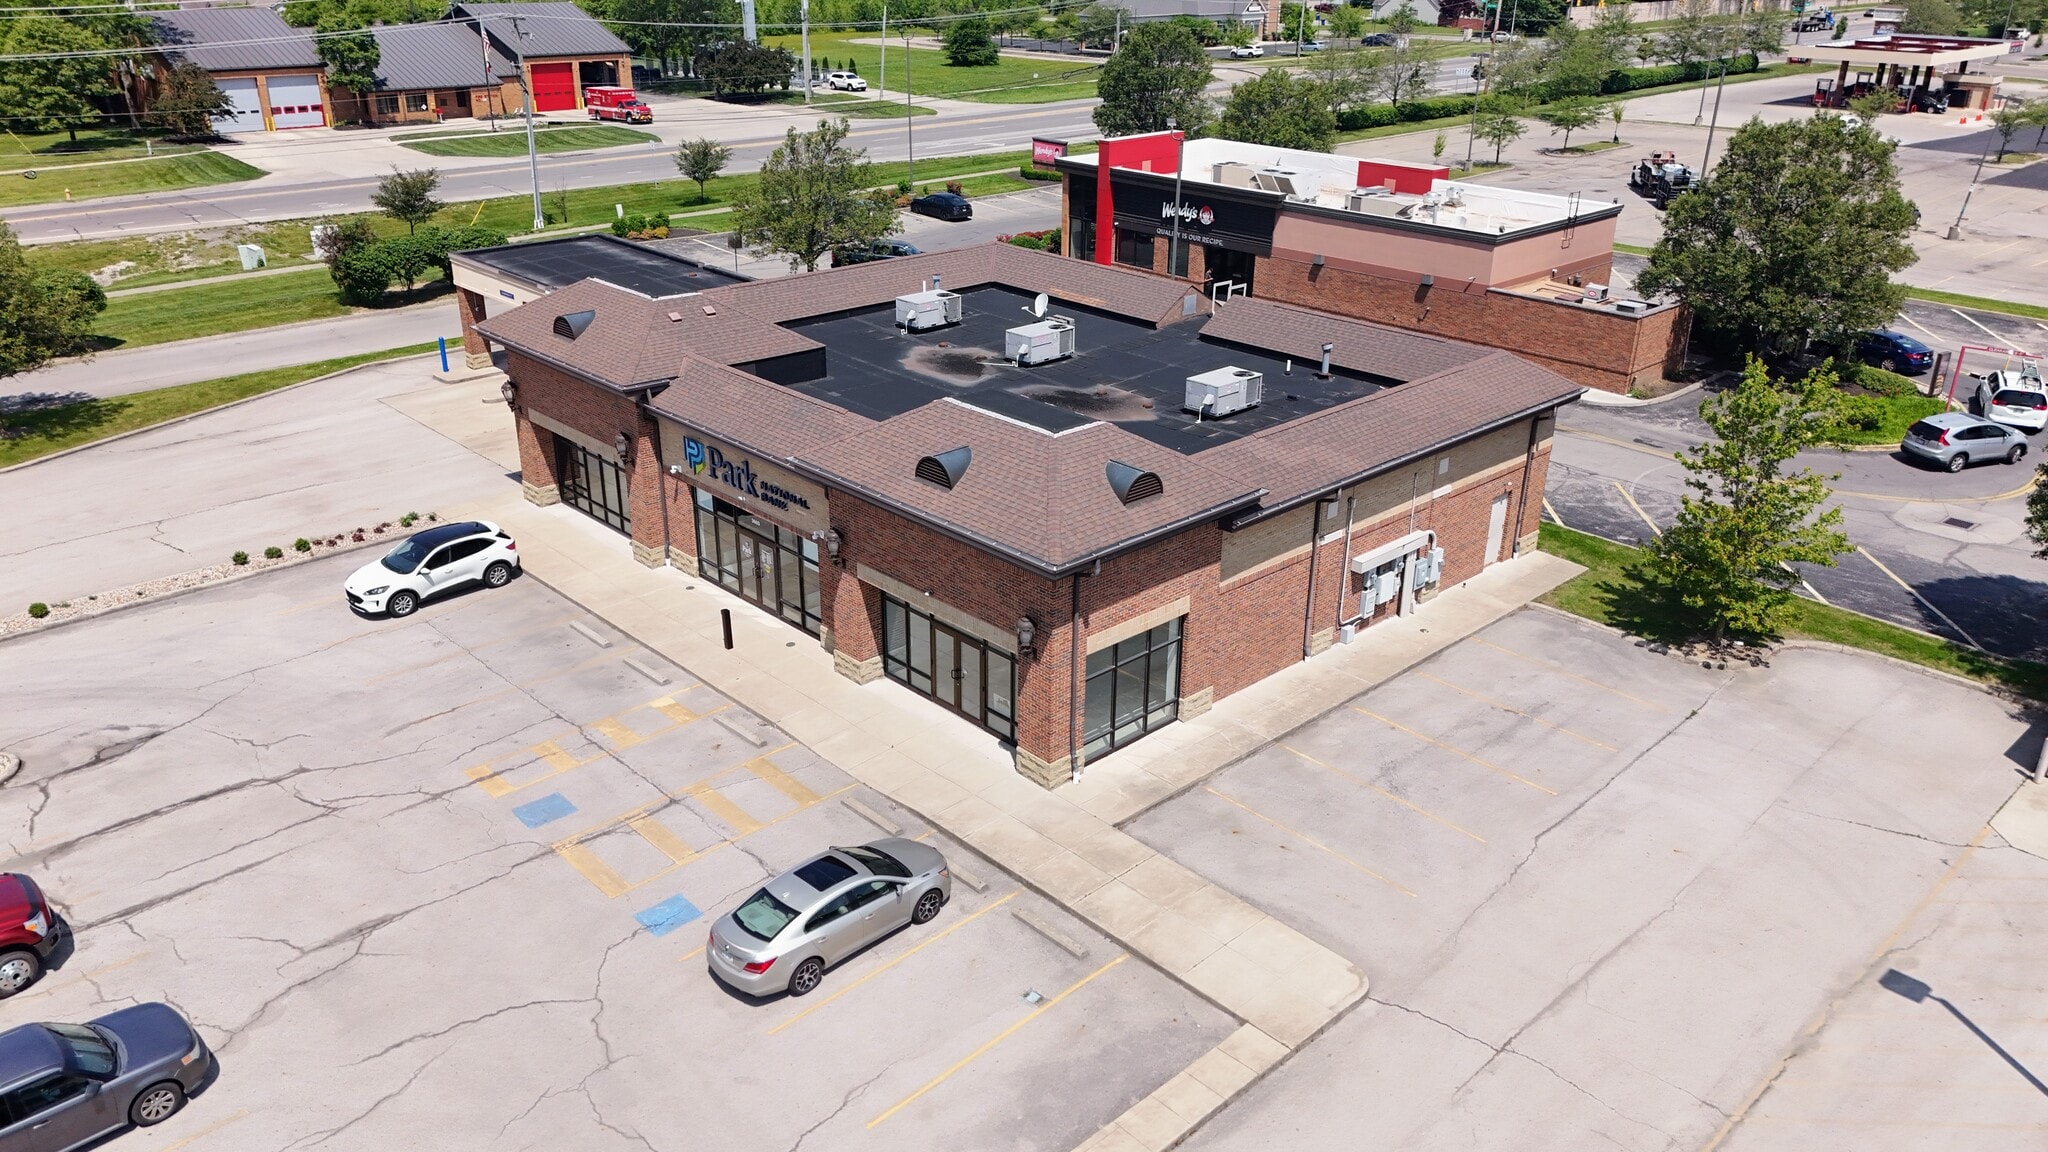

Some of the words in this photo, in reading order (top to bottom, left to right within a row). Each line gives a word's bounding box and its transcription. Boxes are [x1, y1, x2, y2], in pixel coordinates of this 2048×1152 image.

[1156, 228, 1181, 238] QUALIY
[1188, 234, 1201, 242] OUR
[707, 446, 759, 497] Park
[760, 480, 810, 510] NATIONAL
[761, 492, 789, 512] BANK
